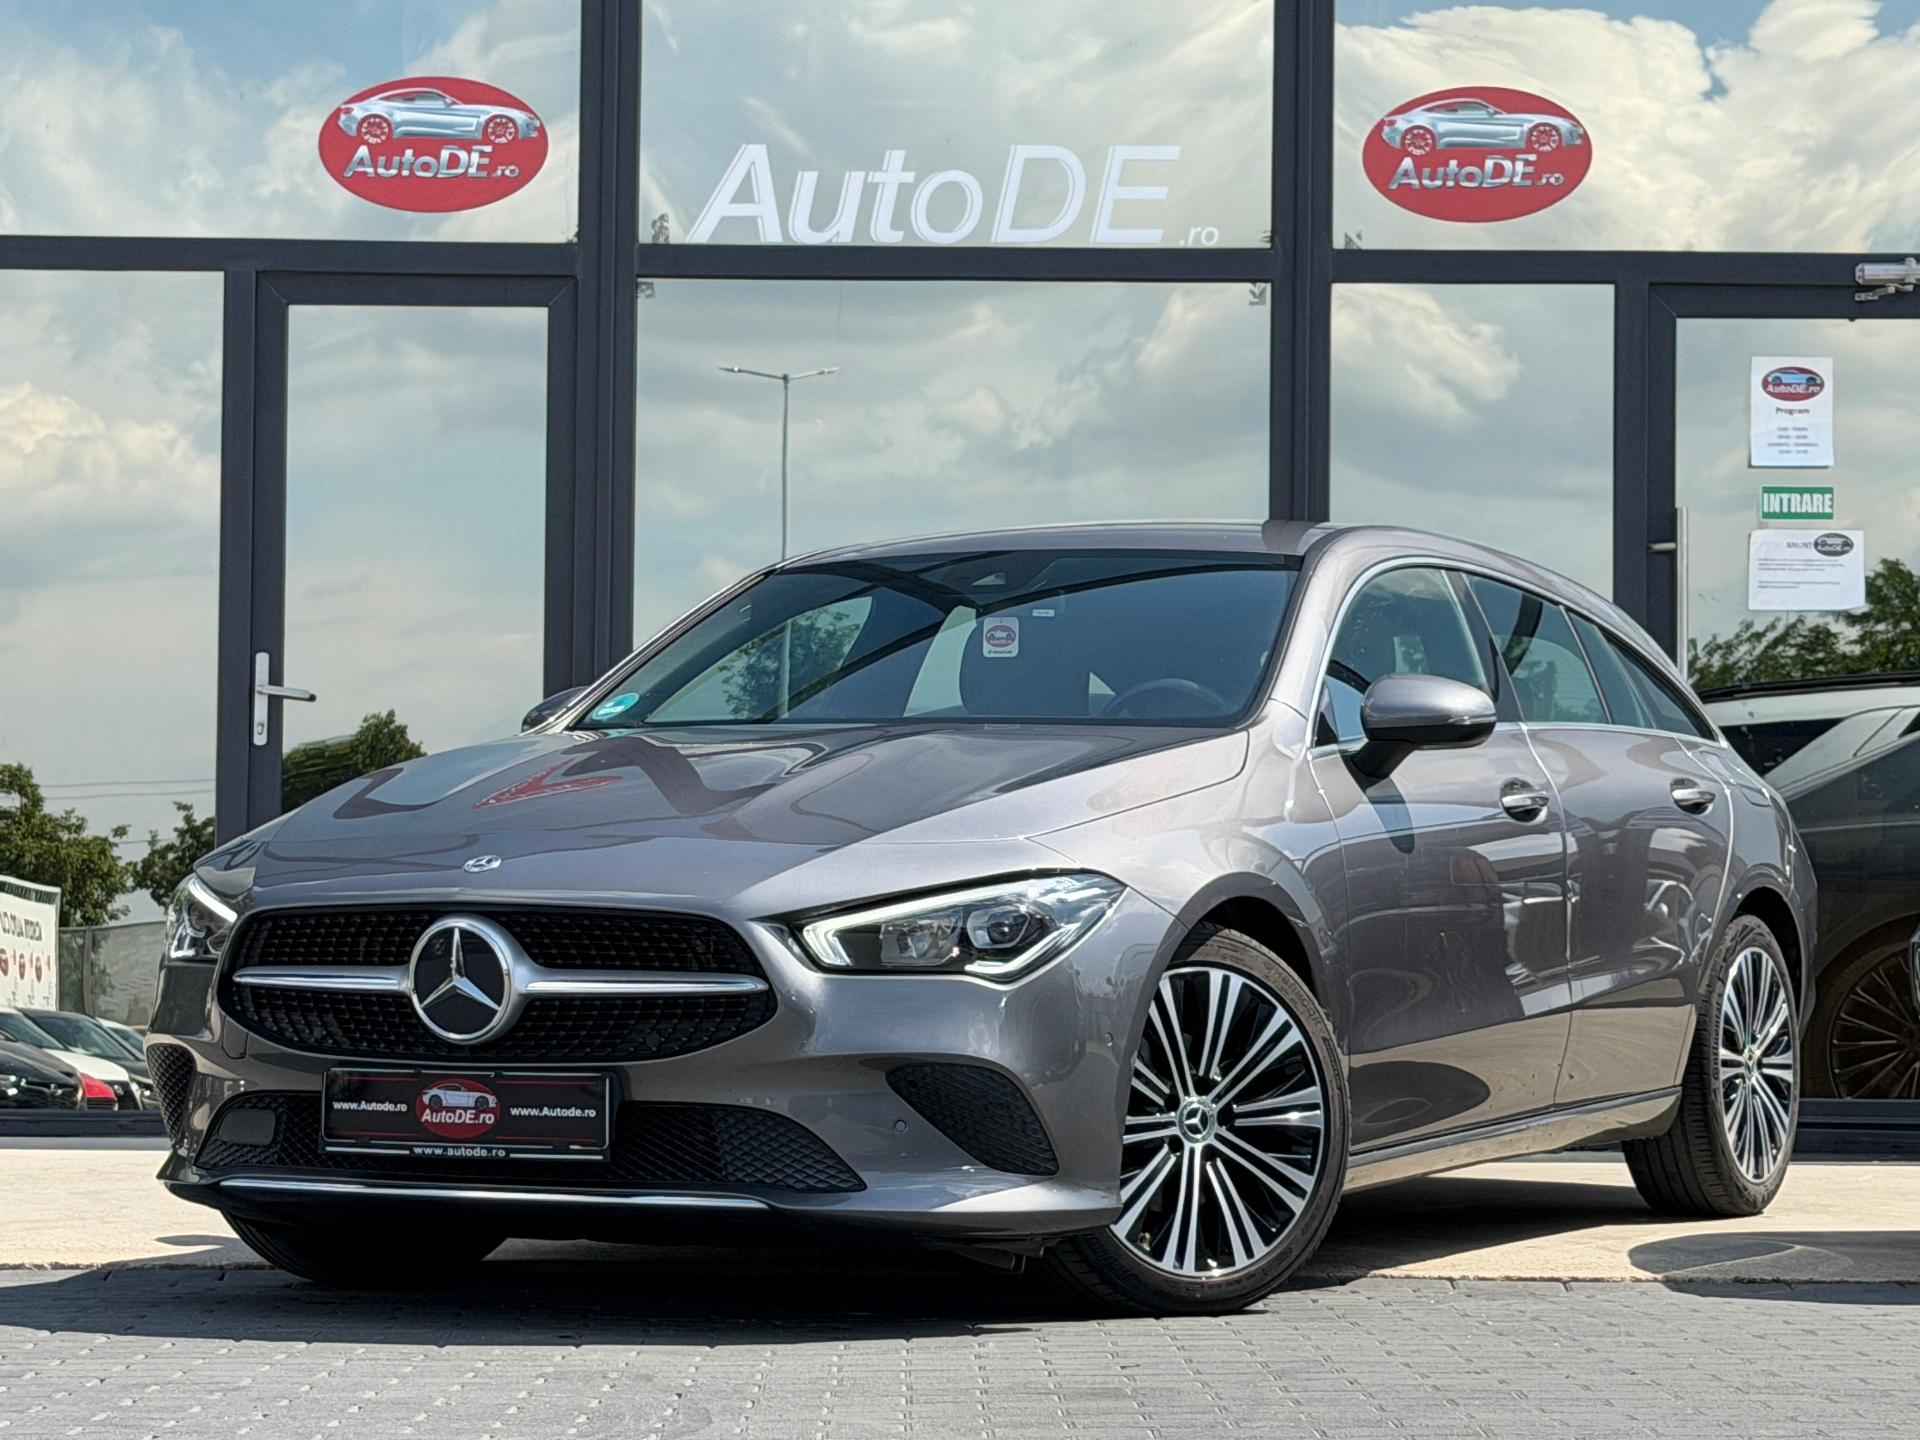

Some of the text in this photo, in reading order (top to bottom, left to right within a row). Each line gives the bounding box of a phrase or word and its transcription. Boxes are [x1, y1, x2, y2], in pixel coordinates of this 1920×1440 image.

[344, 145, 519, 178] AutoDE.ro
[1389, 154, 1564, 189] AutoDE.ro
[687, 144, 1219, 247] AutoDE.ro
[1775, 406, 1810, 416] Program
[1763, 492, 1833, 513] INTRARE
[332, 1099, 409, 1113] www.Autode.ro
[510, 1107, 597, 1118] www.Autode.ro
[421, 1108, 496, 1125] AutoDE.ro
[413, 1146, 507, 1159] www.autode.ro
